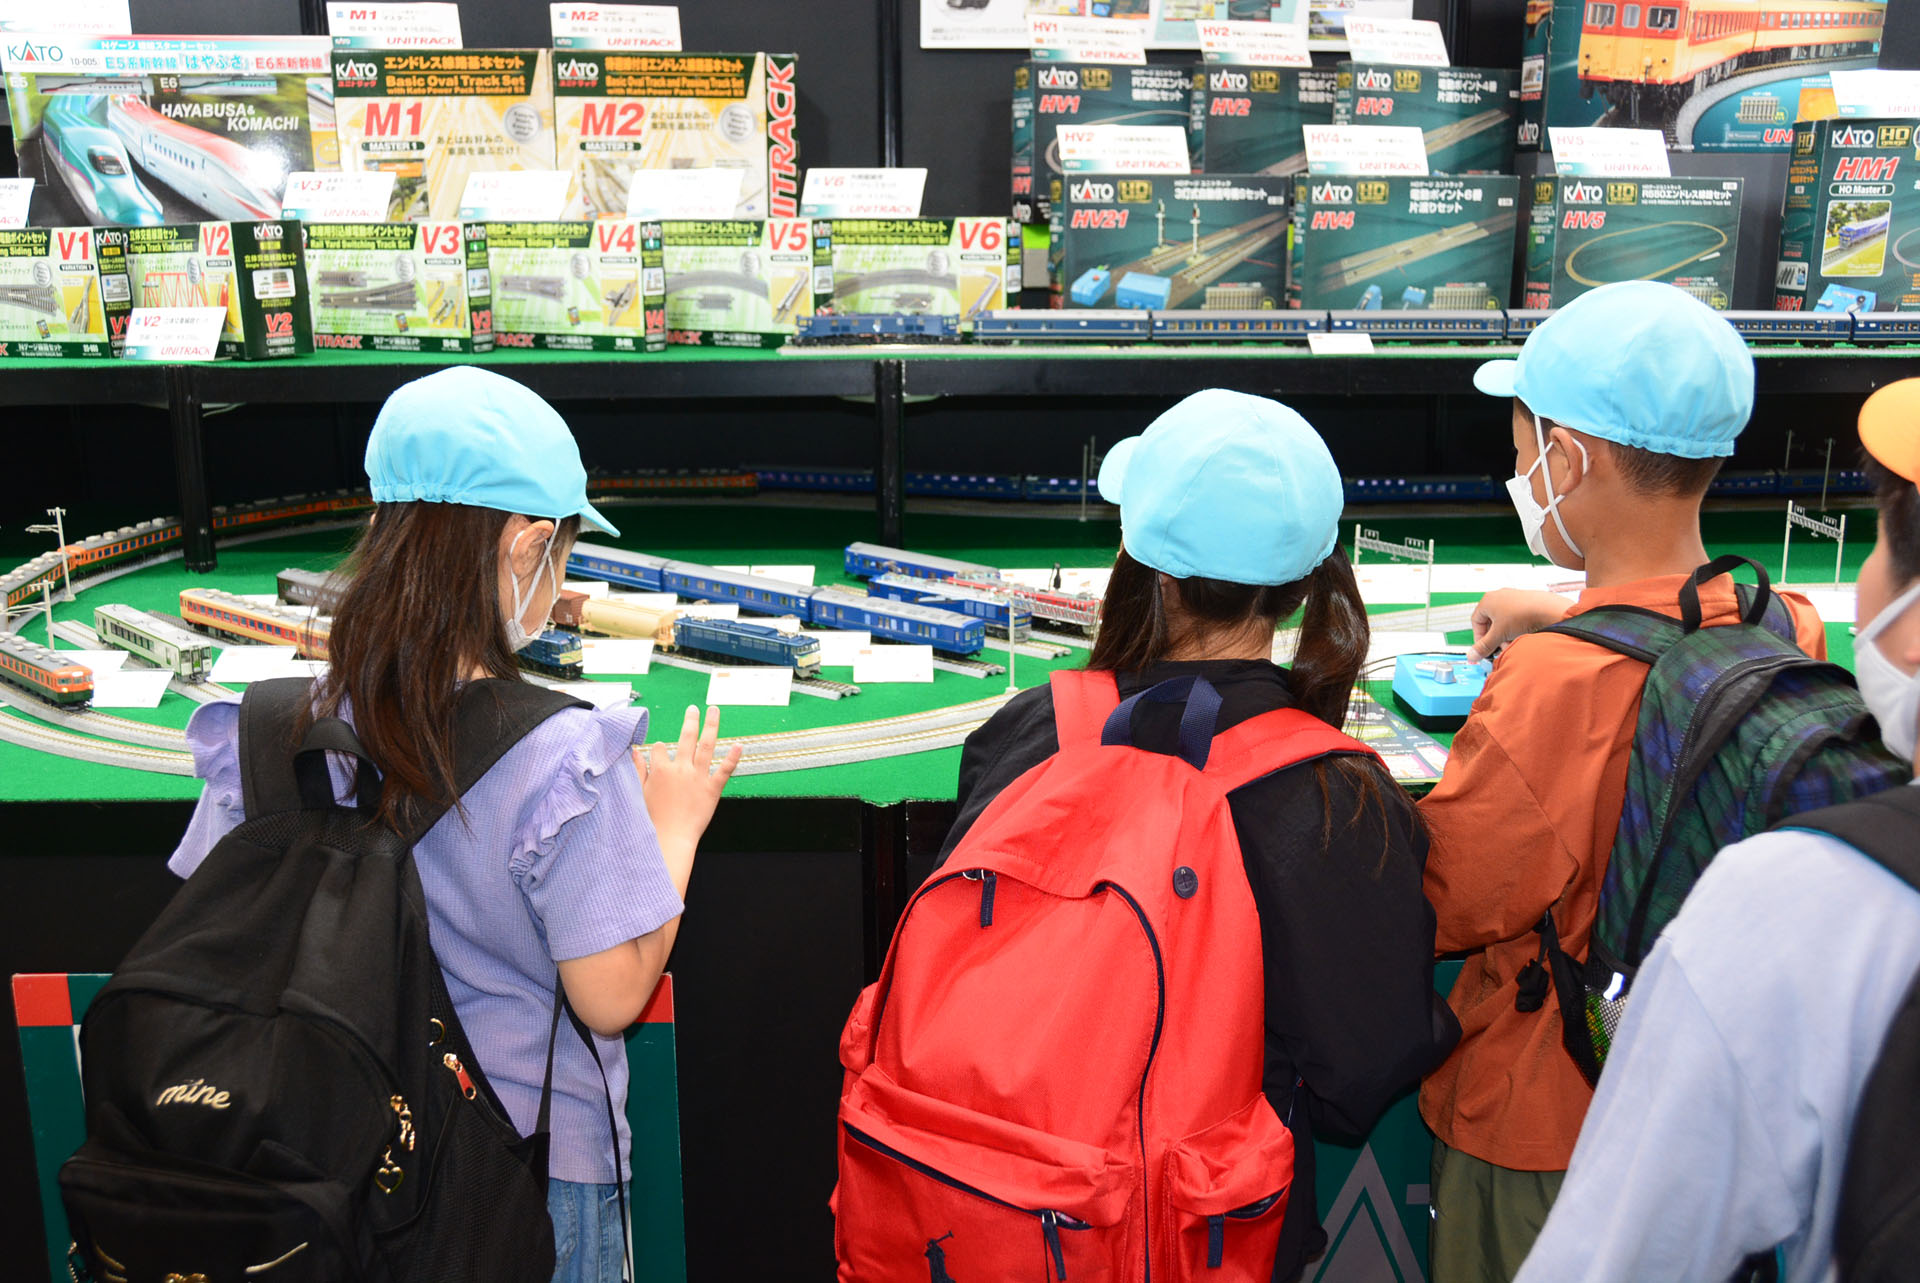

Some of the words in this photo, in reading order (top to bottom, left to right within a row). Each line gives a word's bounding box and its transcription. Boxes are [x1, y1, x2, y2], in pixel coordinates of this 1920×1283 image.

[350, 10, 376, 20] M1
[571, 11, 599, 21] M2
[1033, 22, 1058, 32] HV1
[1203, 26, 1230, 37] HV2
[1350, 22, 1374, 33] HV3
[387, 37, 456, 45] UNITRACK
[607, 38, 675, 46] UNITRACK
[8, 40, 63, 62] KATO
[1080, 51, 1141, 59] UNITRACK
[1249, 53, 1305, 63] UNITRACK
[335, 58, 378, 78] KATO
[557, 58, 599, 77] KATO
[1038, 65, 1078, 86] KATO
[160, 77, 178, 88] E6
[385, 75, 425, 87] Basic
[427, 75, 459, 87] Oval
[460, 75, 500, 87] Track
[501, 75, 525, 87] Set
[1210, 69, 1248, 90] KATO
[1357, 68, 1391, 89] KATO
[1039, 95, 1081, 114] HV1
[1210, 97, 1251, 116] HV2
[1356, 97, 1394, 116] HV3
[227, 116, 299, 131] KOMACHI
[364, 102, 422, 136] M1
[581, 102, 645, 136] M2
[1311, 133, 1340, 144] HV4
[1518, 119, 1539, 142] KATO
[1831, 125, 1875, 145] KATO
[1881, 128, 1910, 140] HO
[1557, 136, 1584, 145] HV5
[1115, 159, 1183, 169] UNITRACK
[1359, 162, 1421, 170] UNITRACK
[1833, 156, 1900, 181] HM1
[300, 180, 322, 191] V3
[823, 176, 845, 186] V6
[1070, 179, 1114, 201] KATO
[1564, 180, 1603, 201] KATO
[1839, 185, 1852, 194] HO
[1853, 185, 1880, 194] Master
[1312, 181, 1353, 202] KATO
[1070, 209, 1129, 229] HV21
[1311, 211, 1356, 230] HV4
[1563, 211, 1606, 229] HV5
[96, 230, 121, 244] KATO
[203, 225, 230, 256] V2
[254, 223, 284, 239] KATO
[421, 225, 460, 255] V3
[598, 224, 636, 253] V4
[768, 222, 808, 251] V5
[958, 222, 1002, 251] V6
[9, 246, 32, 256] Siding
[32, 246, 46, 255] Set
[57, 231, 90, 261] V1
[182, 242, 194, 250] Set
[143, 316, 161, 327] V2
[264, 312, 293, 333] V2
[471, 311, 491, 331] V3
[645, 309, 665, 328] V4
[161, 346, 210, 355] UNITRACK
[156, 1078, 231, 1110] mine
